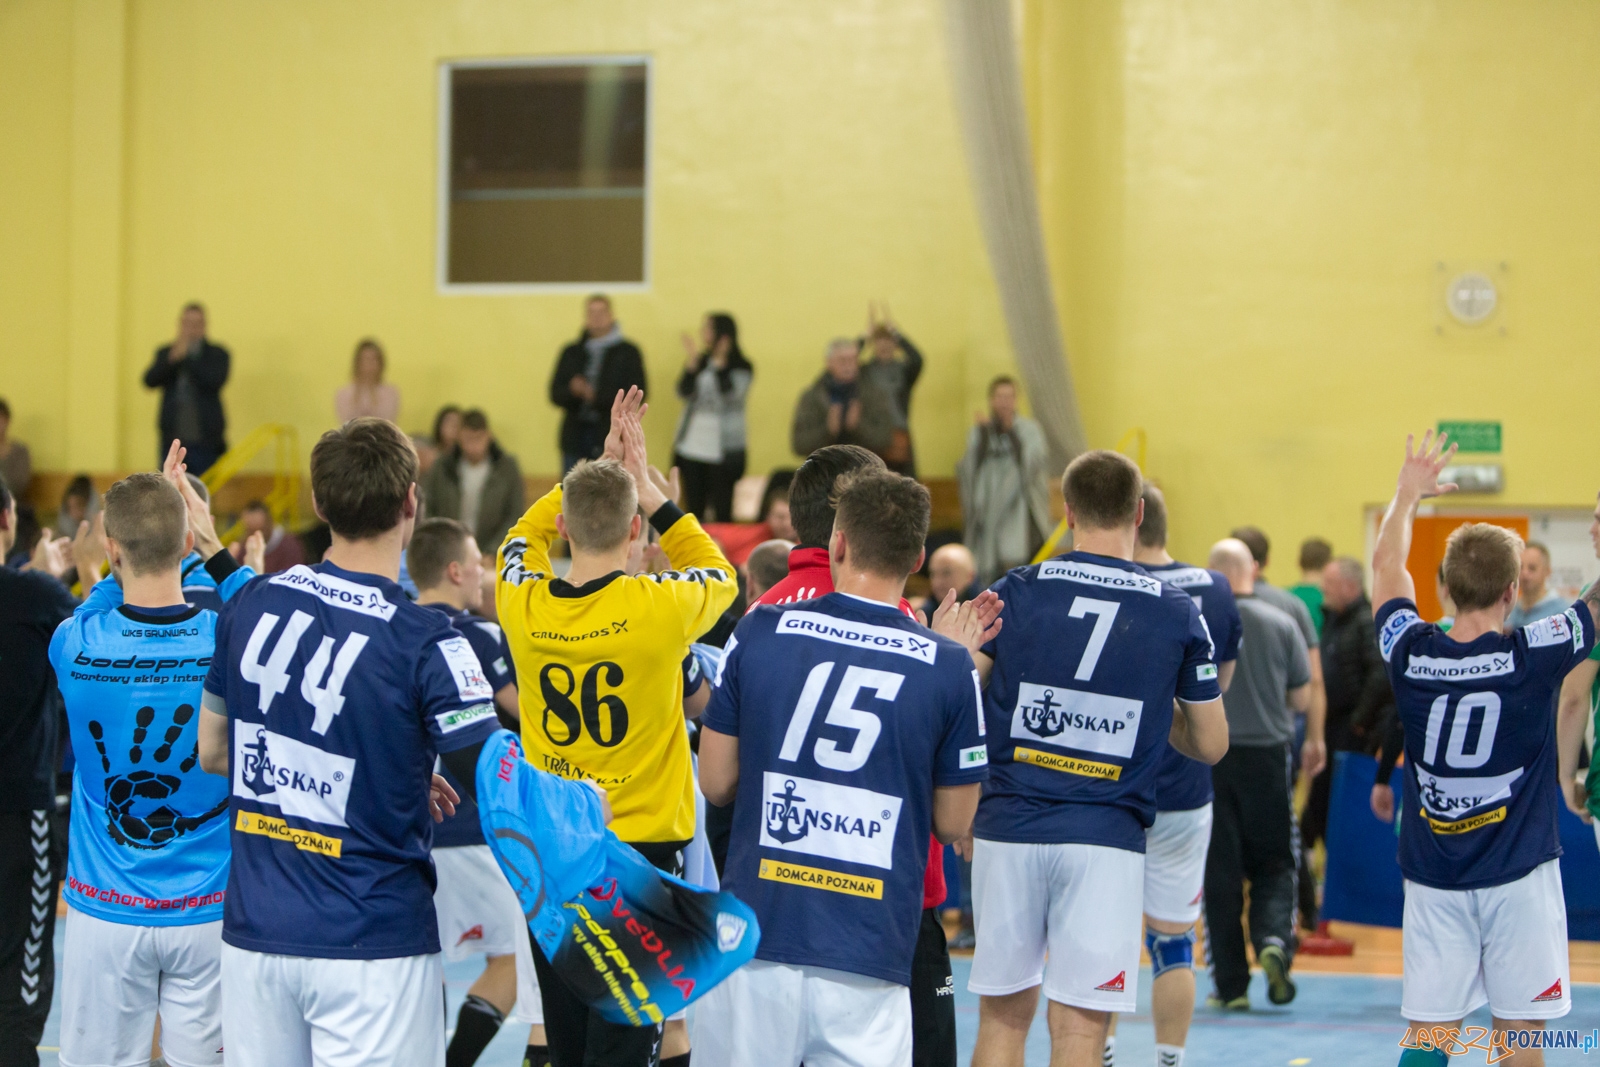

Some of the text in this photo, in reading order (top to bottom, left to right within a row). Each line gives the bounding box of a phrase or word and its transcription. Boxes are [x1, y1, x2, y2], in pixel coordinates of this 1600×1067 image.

[1043, 566, 1137, 588] GRUNDFOS
[121, 628, 199, 638] WKS GRUNWALD
[531, 627, 610, 642] GRUNDFOS
[784, 618, 904, 649] GRUNDFOS
[1067, 595, 1121, 682] 7
[70, 670, 131, 685] sportowy
[133, 674, 169, 684] sklep
[239, 609, 370, 736] 44
[1410, 663, 1492, 678] GRUNDFOS
[539, 661, 629, 748] 86
[778, 660, 906, 772] 15
[1021, 705, 1126, 735] TRANSKAP
[1423, 691, 1502, 769] 10
[1035, 754, 1115, 777] DOMCAR POZNAŃ
[293, 834, 333, 852] OZNAŃ
[775, 866, 875, 894] DOMCAR POZNAŃ
